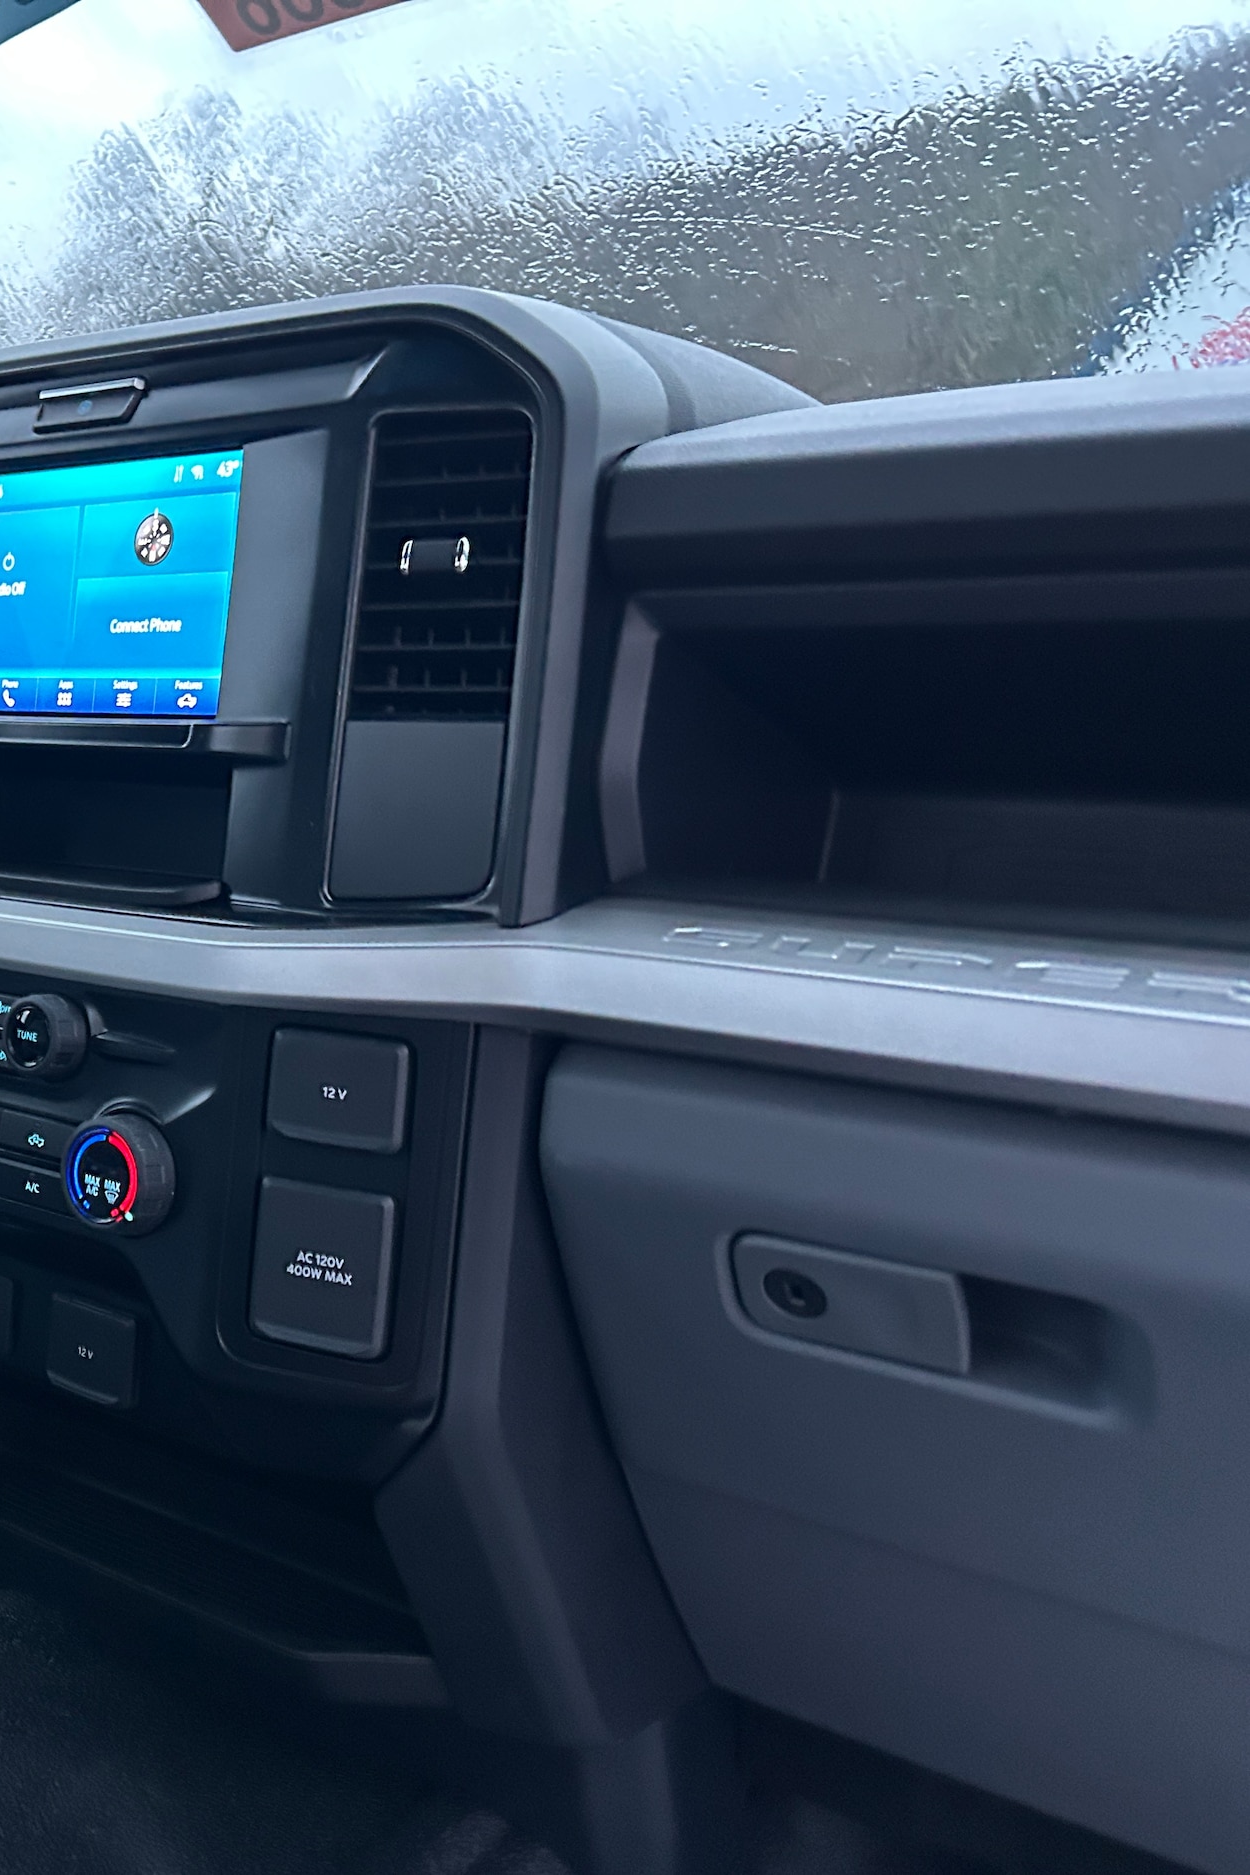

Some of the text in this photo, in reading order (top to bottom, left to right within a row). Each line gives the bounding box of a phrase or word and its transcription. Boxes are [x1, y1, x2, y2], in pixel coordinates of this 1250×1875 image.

[110, 617, 183, 634] Connect Phone
[17, 1029, 38, 1043] TUNE
[25, 1180, 40, 1194] A/C
[84, 1173, 101, 1187] MAX
[103, 1179, 121, 1193] MAX
[296, 1249, 345, 1270] AC 120V
[286, 1263, 353, 1287] 400W MAX
